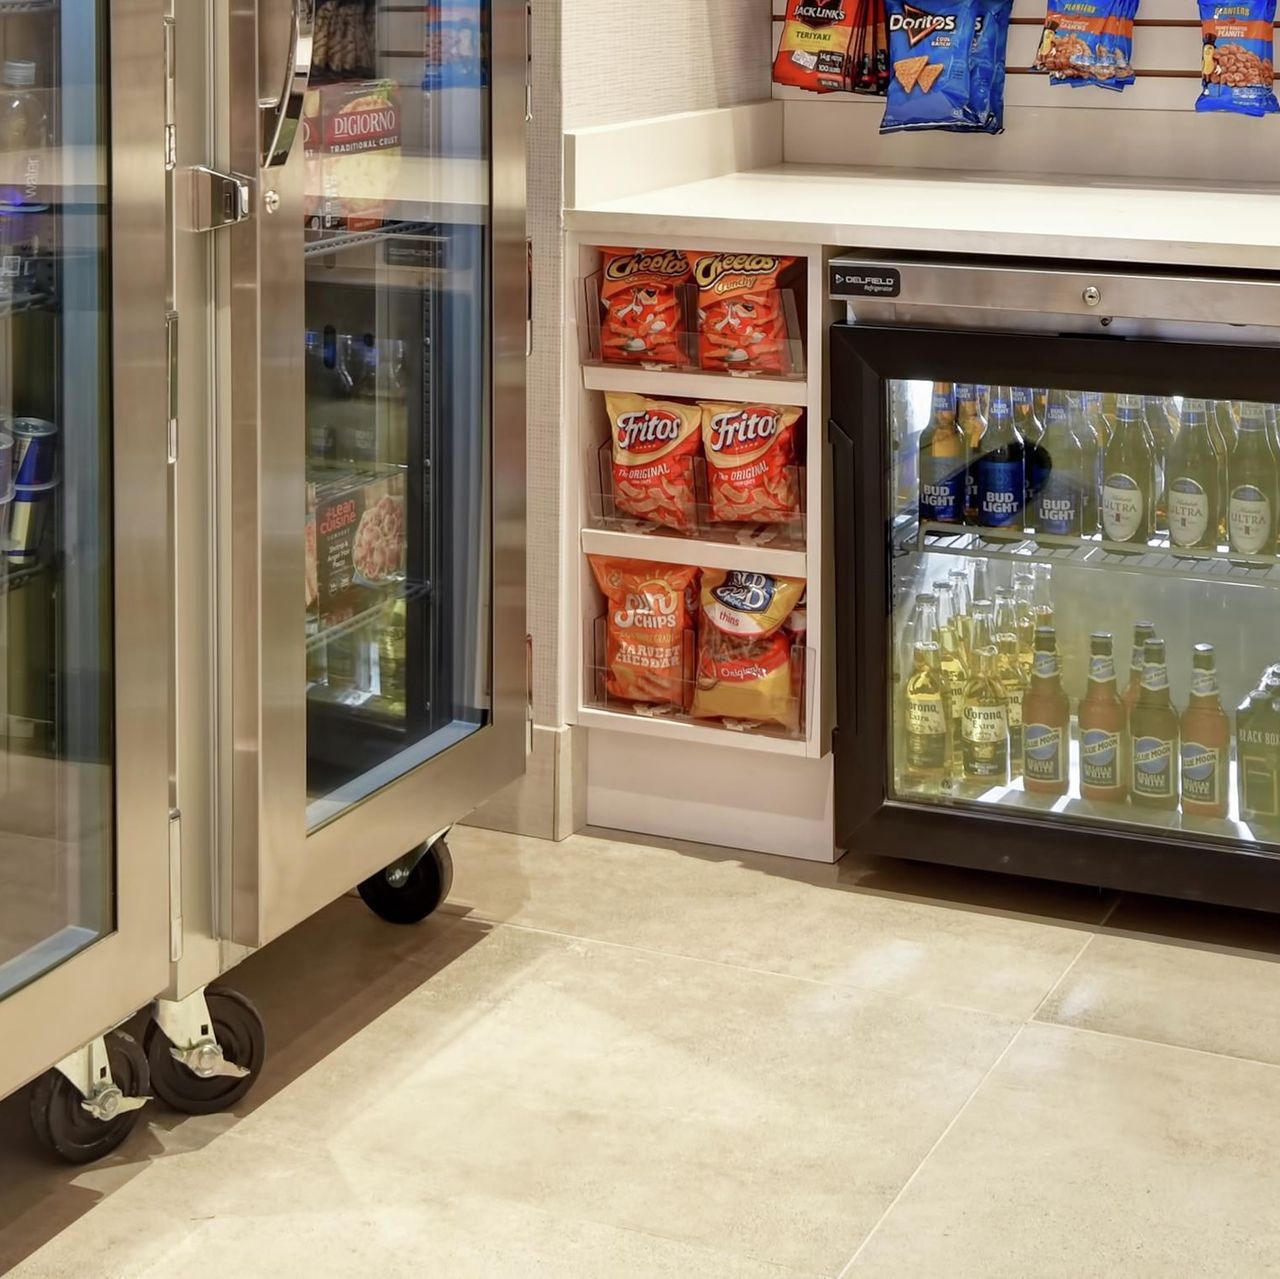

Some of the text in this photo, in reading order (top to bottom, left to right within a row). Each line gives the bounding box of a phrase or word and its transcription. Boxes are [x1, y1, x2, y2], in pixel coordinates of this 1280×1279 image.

[793, 5, 816, 18] JACK
[889, 14, 956, 31] Doritos
[796, 31, 831, 41] TERIYAKI
[1217, 30, 1245, 38] PEANUTS
[330, 136, 399, 154] TRADITIONAL CRUST
[609, 250, 689, 277] Cheetos
[695, 254, 779, 287] Cheetos
[715, 276, 756, 294] Crunchy
[845, 275, 894, 285] DELFIELD
[617, 410, 681, 449] Fritos
[711, 410, 779, 451] Fritos
[628, 463, 670, 479] ORIGINAL
[730, 460, 769, 480] ORIGINAL
[923, 484, 950, 496] BUD
[986, 491, 1014, 502] BUD
[921, 494, 955, 506] LIGHT
[1042, 499, 1071, 510] BUD
[1104, 500, 1137, 513] ULTRA
[983, 501, 1019, 513] LIGHT
[1039, 509, 1075, 520] LIGHT
[1231, 512, 1267, 525] ULTRA
[320, 511, 356, 535] cuisine
[634, 614, 677, 629] CHIPS
[719, 611, 740, 627] thins
[964, 706, 1004, 721] Corona
[1039, 733, 1060, 745] MOON
[1239, 730, 1280, 745] BLACK BOX
[1097, 739, 1118, 751] MOON
[1150, 747, 1170, 758] MOON
[1195, 754, 1217, 763] MOON
[1028, 765, 1052, 774] WHITE
[1086, 771, 1112, 779] WHITE
[1138, 779, 1165, 787] WHITE
